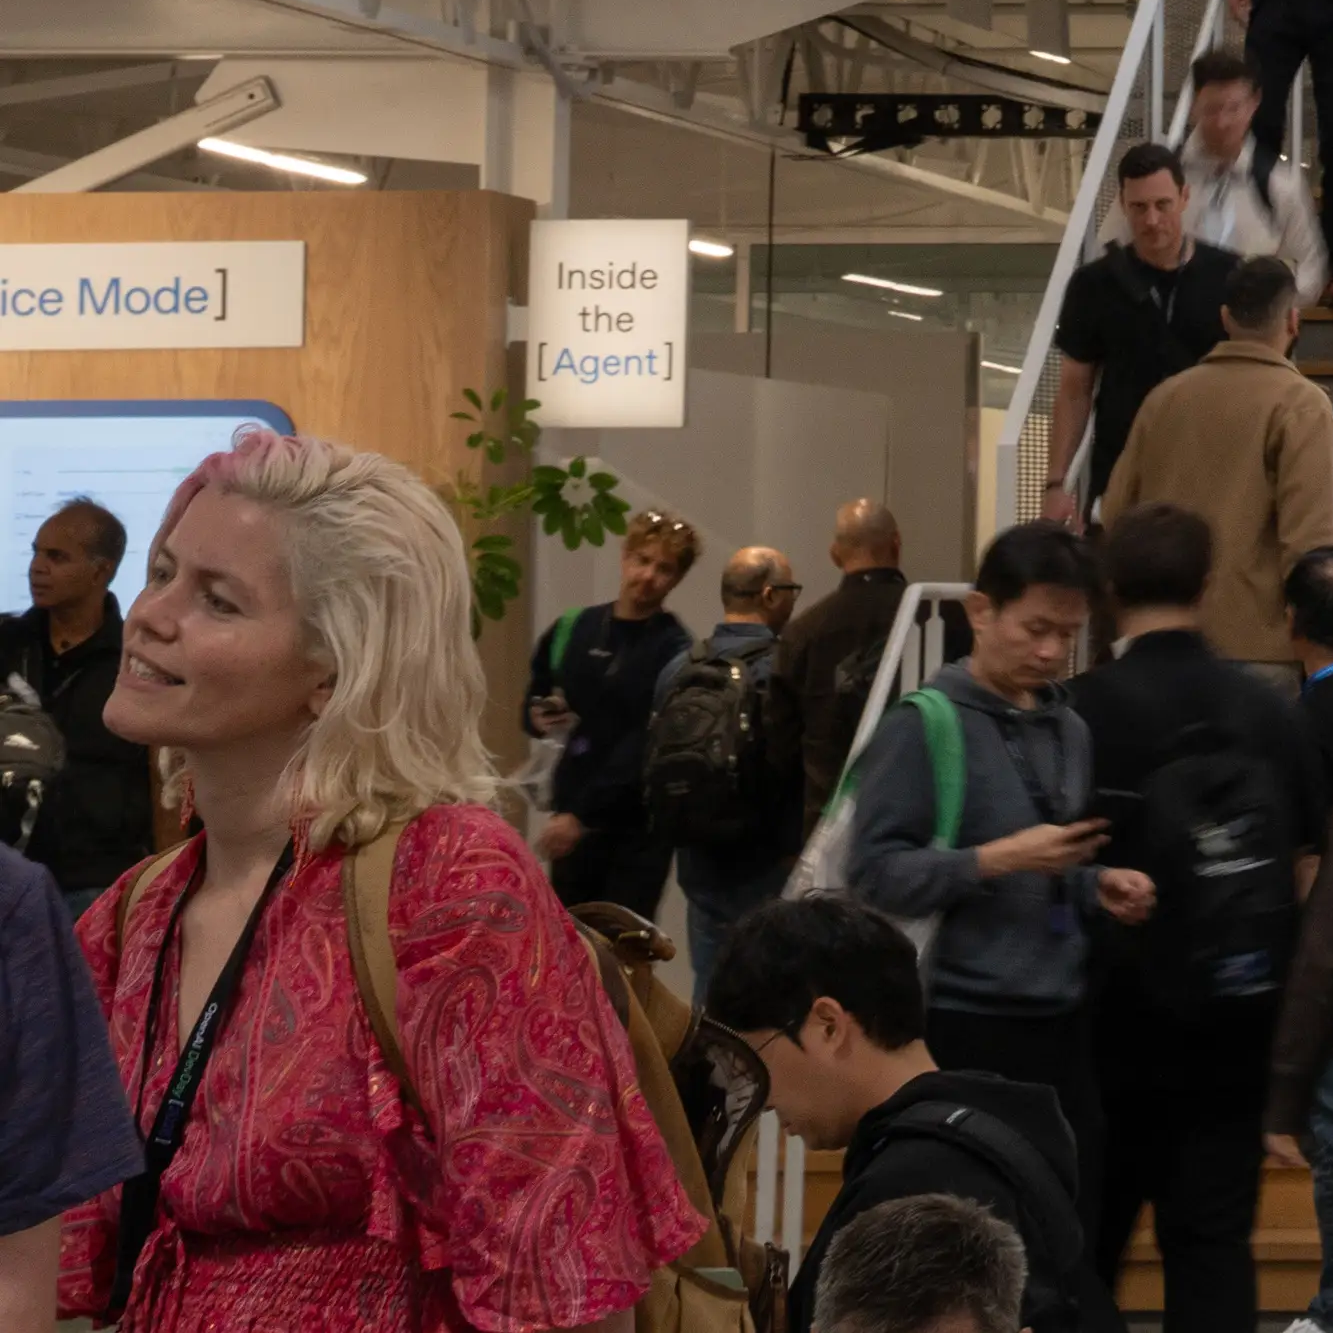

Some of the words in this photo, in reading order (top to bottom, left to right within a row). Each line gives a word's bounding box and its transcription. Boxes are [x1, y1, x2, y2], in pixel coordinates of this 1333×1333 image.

[557, 262, 658, 291] Inside
[79, 268, 228, 322] Mode]
[578, 305, 634, 333] the
[538, 342, 673, 384] [Agent]
